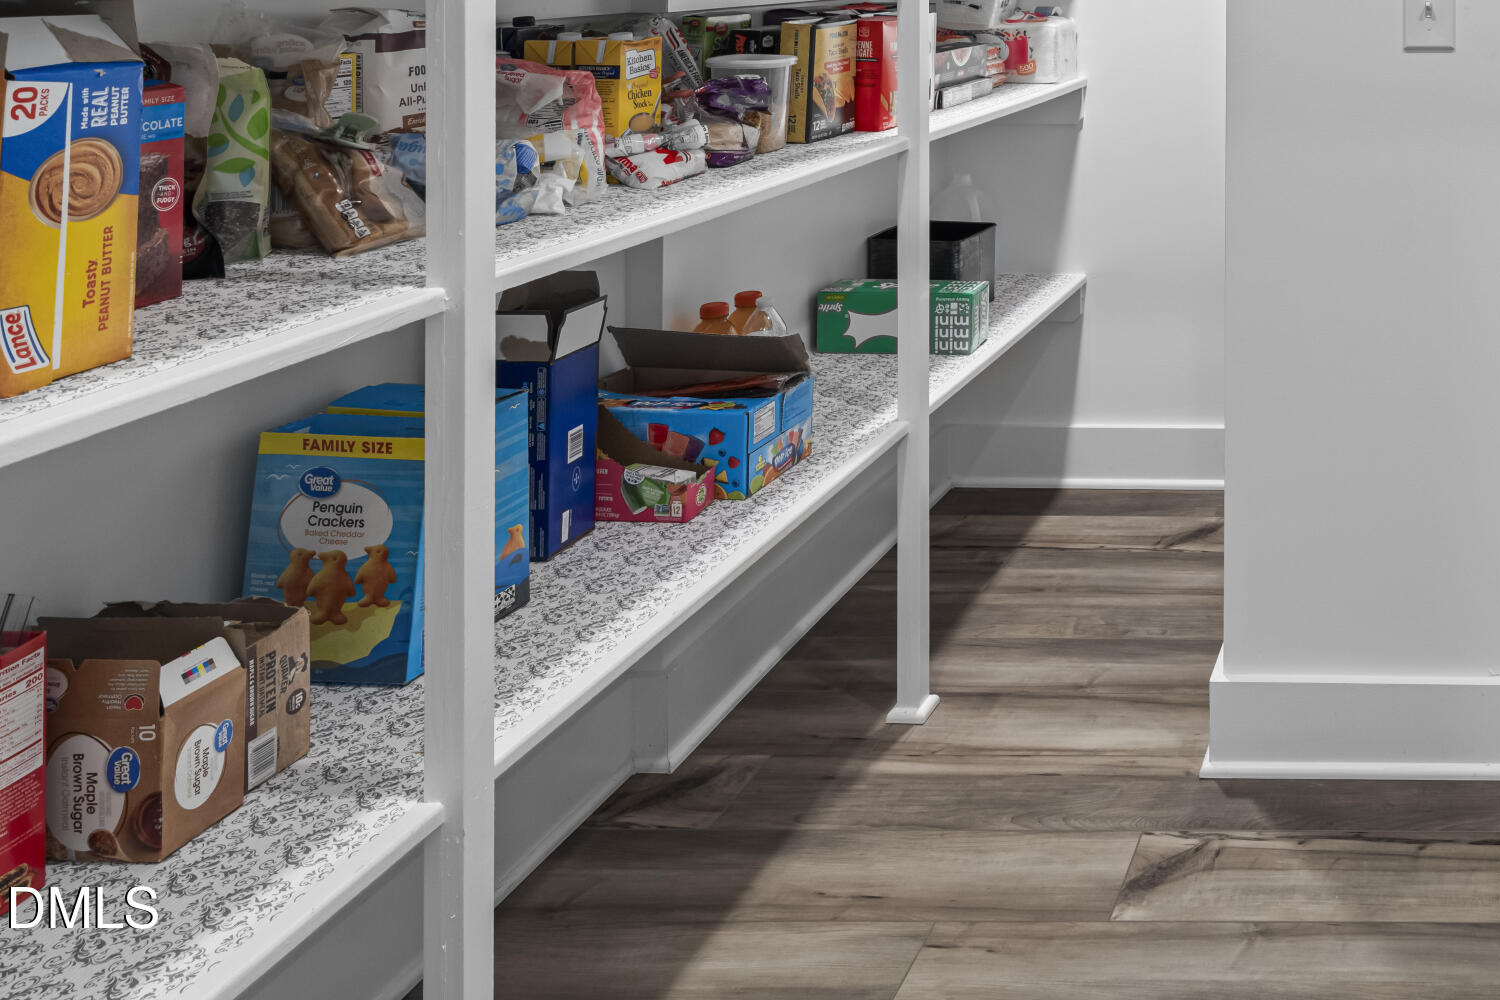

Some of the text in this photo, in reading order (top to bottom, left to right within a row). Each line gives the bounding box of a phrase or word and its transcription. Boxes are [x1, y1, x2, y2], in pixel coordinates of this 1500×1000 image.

[626, 53, 653, 66] Kitchen
[629, 63, 651, 75] Basics
[10, 86, 38, 121] 20
[38, 88, 50, 117] PACKS
[161, 95, 176, 104] SIZE
[627, 89, 652, 101] Chicken
[632, 100, 648, 109] Stock
[80, 87, 90, 129] Made with
[90, 86, 110, 128] REAL
[110, 86, 120, 126] PEANUT
[120, 86, 130, 125] BUTTER
[812, 121, 821, 132] 12
[82, 259, 98, 309] Toasty
[98, 225, 114, 332] PEANUT BUTTER
[818, 302, 843, 313] Sprite
[5, 312, 37, 371] Lance
[302, 437, 393, 455] FAMILY SIZE
[304, 473, 335, 486] Great
[310, 482, 333, 493] Value
[312, 501, 364, 516] Penguin
[672, 505, 682, 514] 12
[307, 514, 366, 529] Crackers
[304, 528, 366, 538] Baked Cheddar
[319, 537, 349, 546] Cheese
[21, 651, 41, 666] Facts
[25, 671, 44, 689] 200
[265, 650, 278, 715] PROTEIN
[279, 654, 288, 695] QUAKER
[138, 723, 157, 742] 10
[120, 751, 134, 785] Great
[193, 738, 202, 797] Brown Sugar
[201, 746, 211, 778] Maple
[113, 759, 122, 786] Value
[70, 752, 85, 835] Brown Sugar
[85, 771, 98, 816] Maple
